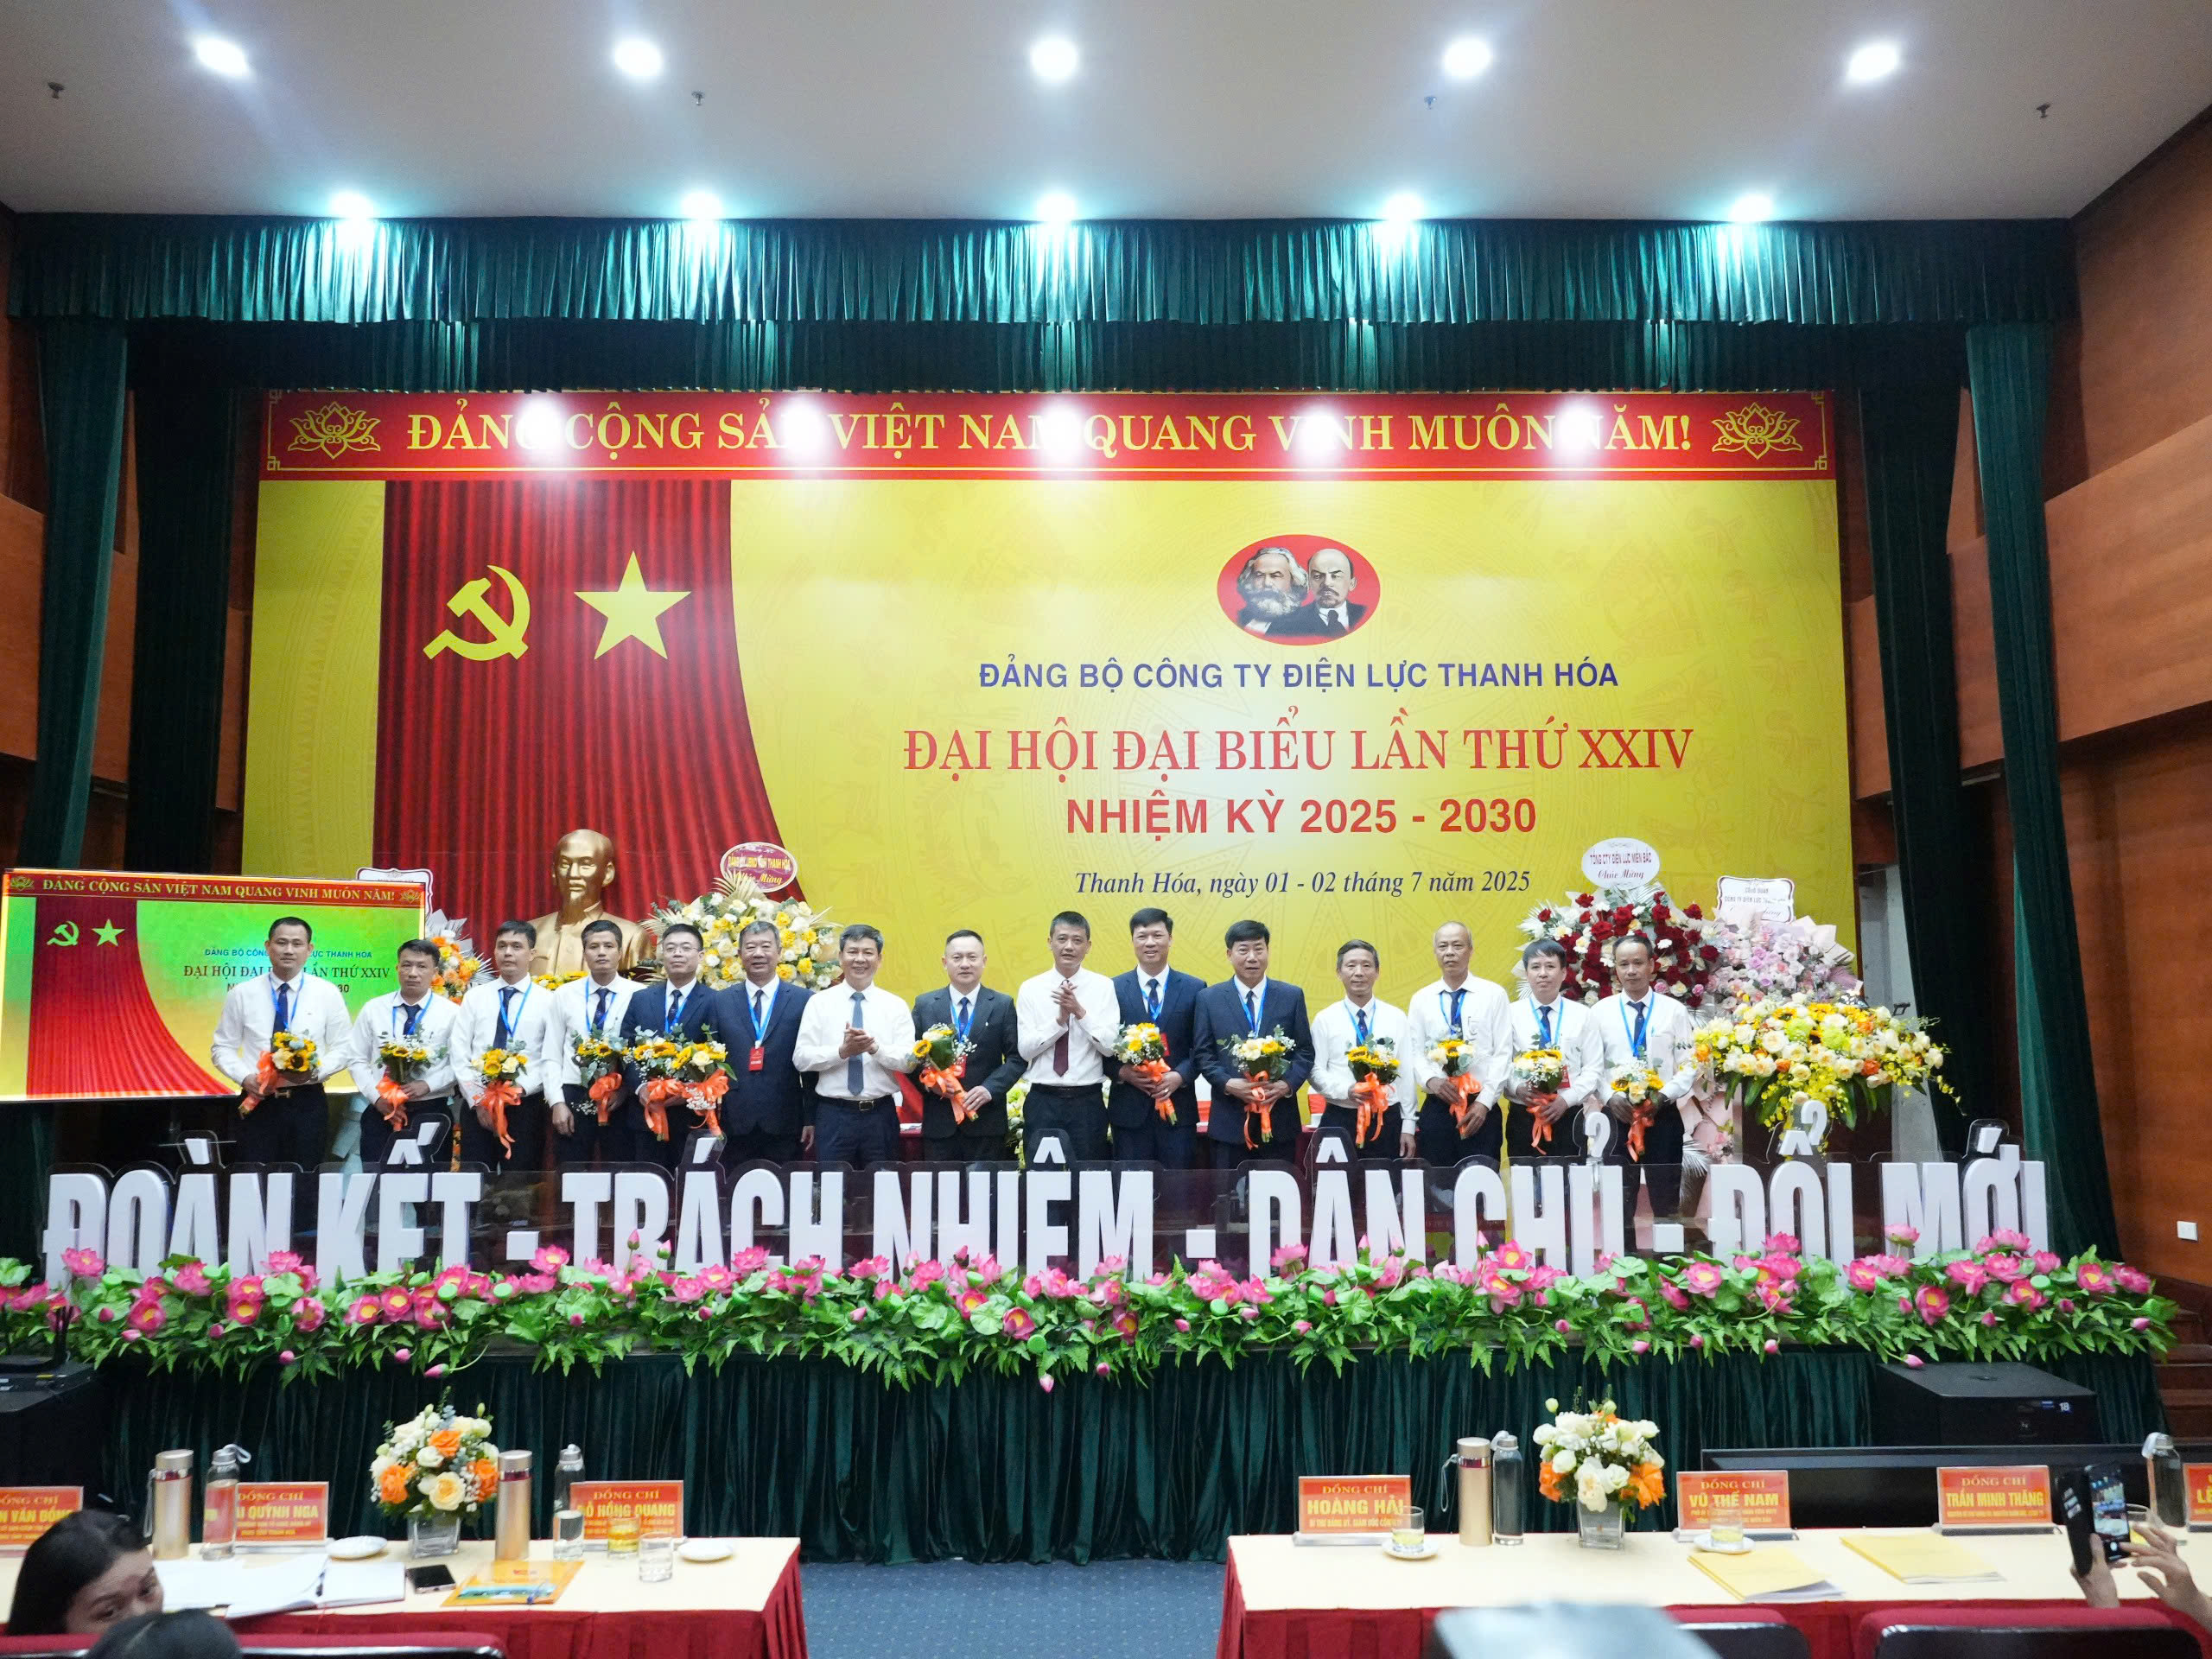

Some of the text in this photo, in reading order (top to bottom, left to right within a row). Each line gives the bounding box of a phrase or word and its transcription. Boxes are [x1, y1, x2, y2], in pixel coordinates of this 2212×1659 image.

[407, 398, 546, 450] ĐẢN
[565, 402, 705, 461] CỘNG
[718, 397, 802, 449] SẢ
[828, 402, 945, 460] VIỆT
[1084, 414, 1256, 459] QUANG
[1268, 415, 1394, 451] VNH
[1408, 403, 1559, 450] MUÔN
[979, 653, 1619, 693] ĐẢNG BỘ CÔNG TY ĐIỆN LỰC THANH HÓA
[904, 705, 1694, 783] ĐẠI HỘI ĐẠI BIỂU LẦN THỨ XXIV
[1067, 789, 1208, 841] NHIỆM
[1227, 789, 1285, 833] KỲ
[1300, 799, 1397, 833] 2025
[1440, 798, 1537, 833] 2030
[201, 885, 232, 896] NAM
[235, 887, 283, 899] QUANG
[286, 887, 318, 899] VINH
[1075, 872, 1145, 893] Thanh
[1151, 872, 1202, 897] Hóa,
[1210, 872, 1259, 898] ngày
[1264, 872, 1289, 893] 01
[1312, 872, 1337, 893] 02
[1344, 871, 1404, 897] tháng
[1410, 871, 1423, 893] 7
[1429, 871, 1474, 893] năm
[1481, 870, 1530, 892] 2025
[361, 968, 390, 978] XXIV
[43, 1138, 293, 1285] ĐOÀN
[316, 1122, 482, 1282] KẾT
[562, 1137, 844, 1274] TRÁCH
[872, 1137, 1154, 1282] NHIỆM
[1248, 1136, 1427, 1277] DÂN
[1452, 1111, 1625, 1275] CHỦ
[1707, 1100, 1856, 1268] ĐỔI
[1880, 1127, 2050, 1257] MỚI
[1306, 1497, 1369, 1515] HOÀNG
[1744, 1492, 1779, 1507] NAM
[1976, 1492, 2006, 1507] MINH
[293, 1505, 319, 1518] NGA
[634, 1503, 676, 1517] QUANG
